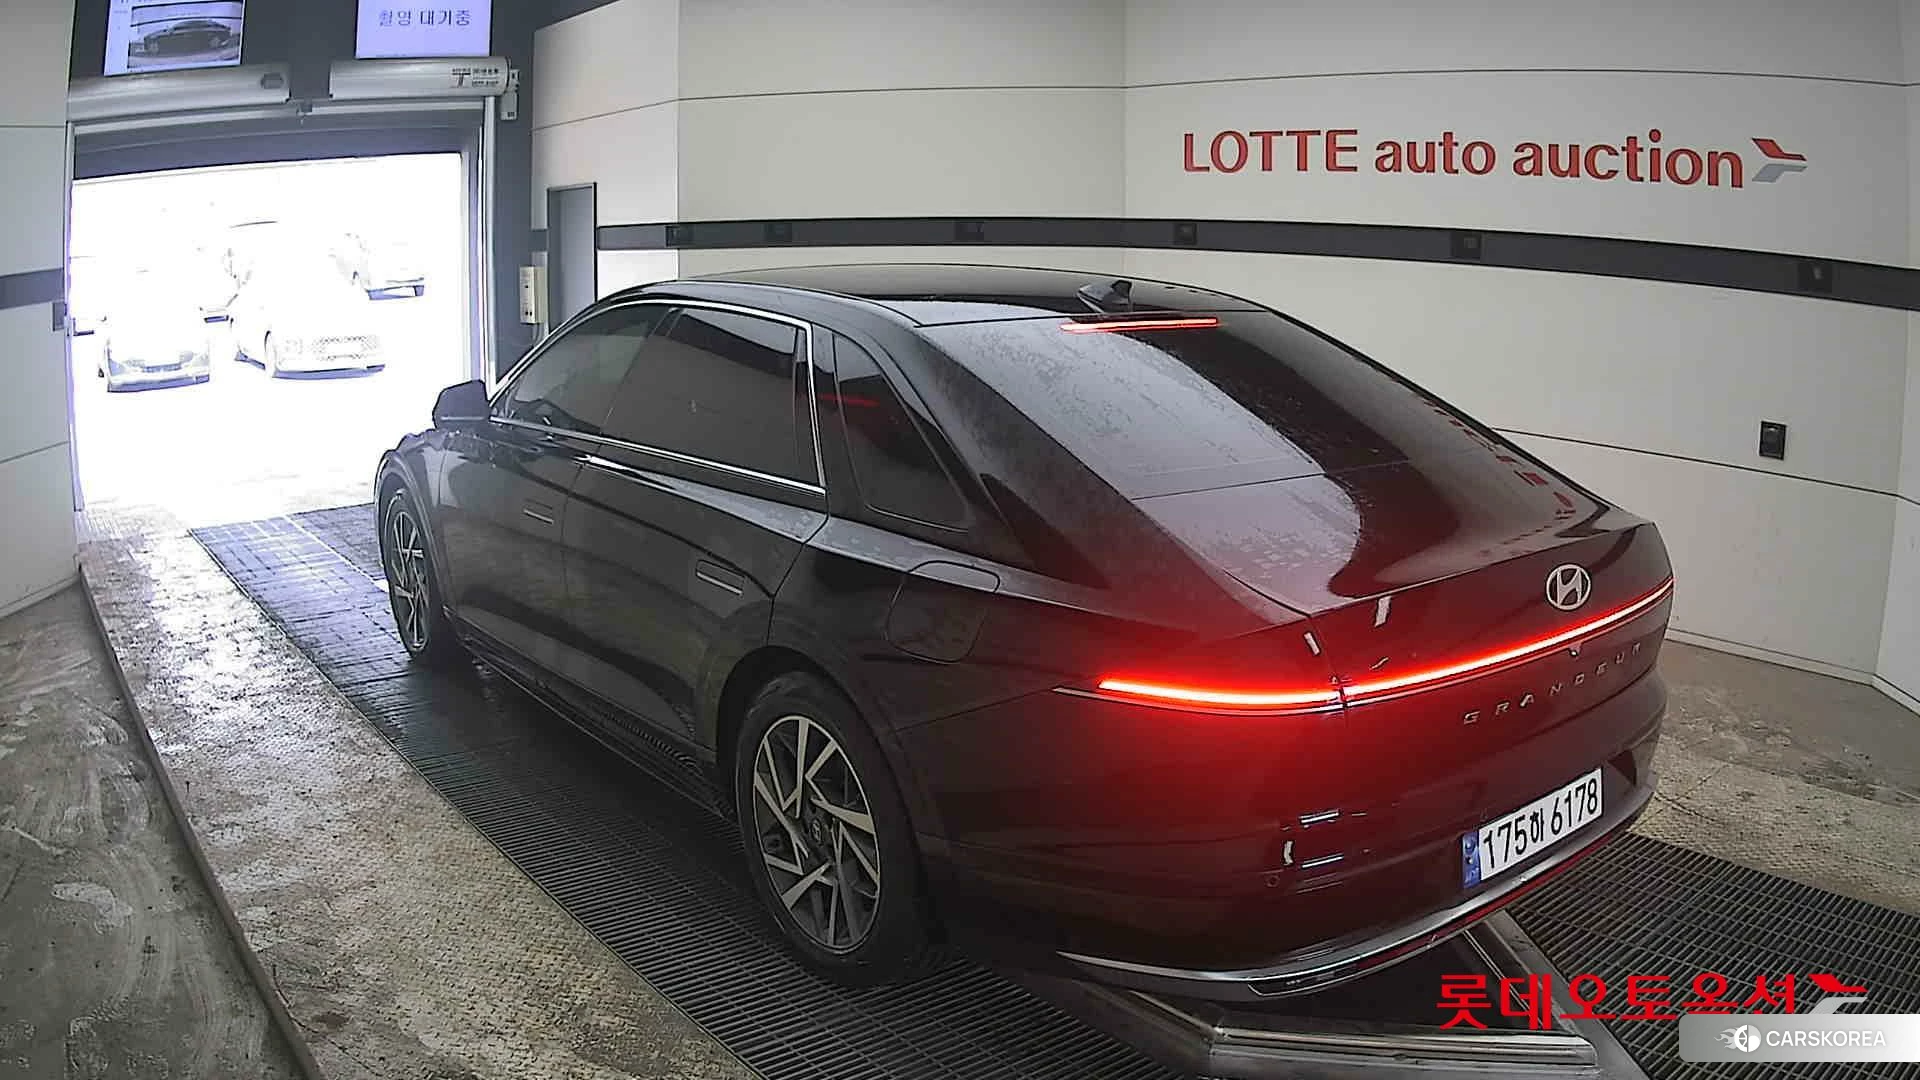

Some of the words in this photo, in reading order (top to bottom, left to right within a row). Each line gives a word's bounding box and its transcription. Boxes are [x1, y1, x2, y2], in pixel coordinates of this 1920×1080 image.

[420, 9, 471, 26] 대기중
[1184, 130, 1357, 173] LOTTE
[1375, 131, 1496, 175] auto
[1513, 129, 1744, 188] auction
[1551, 778, 1598, 836] 6178
